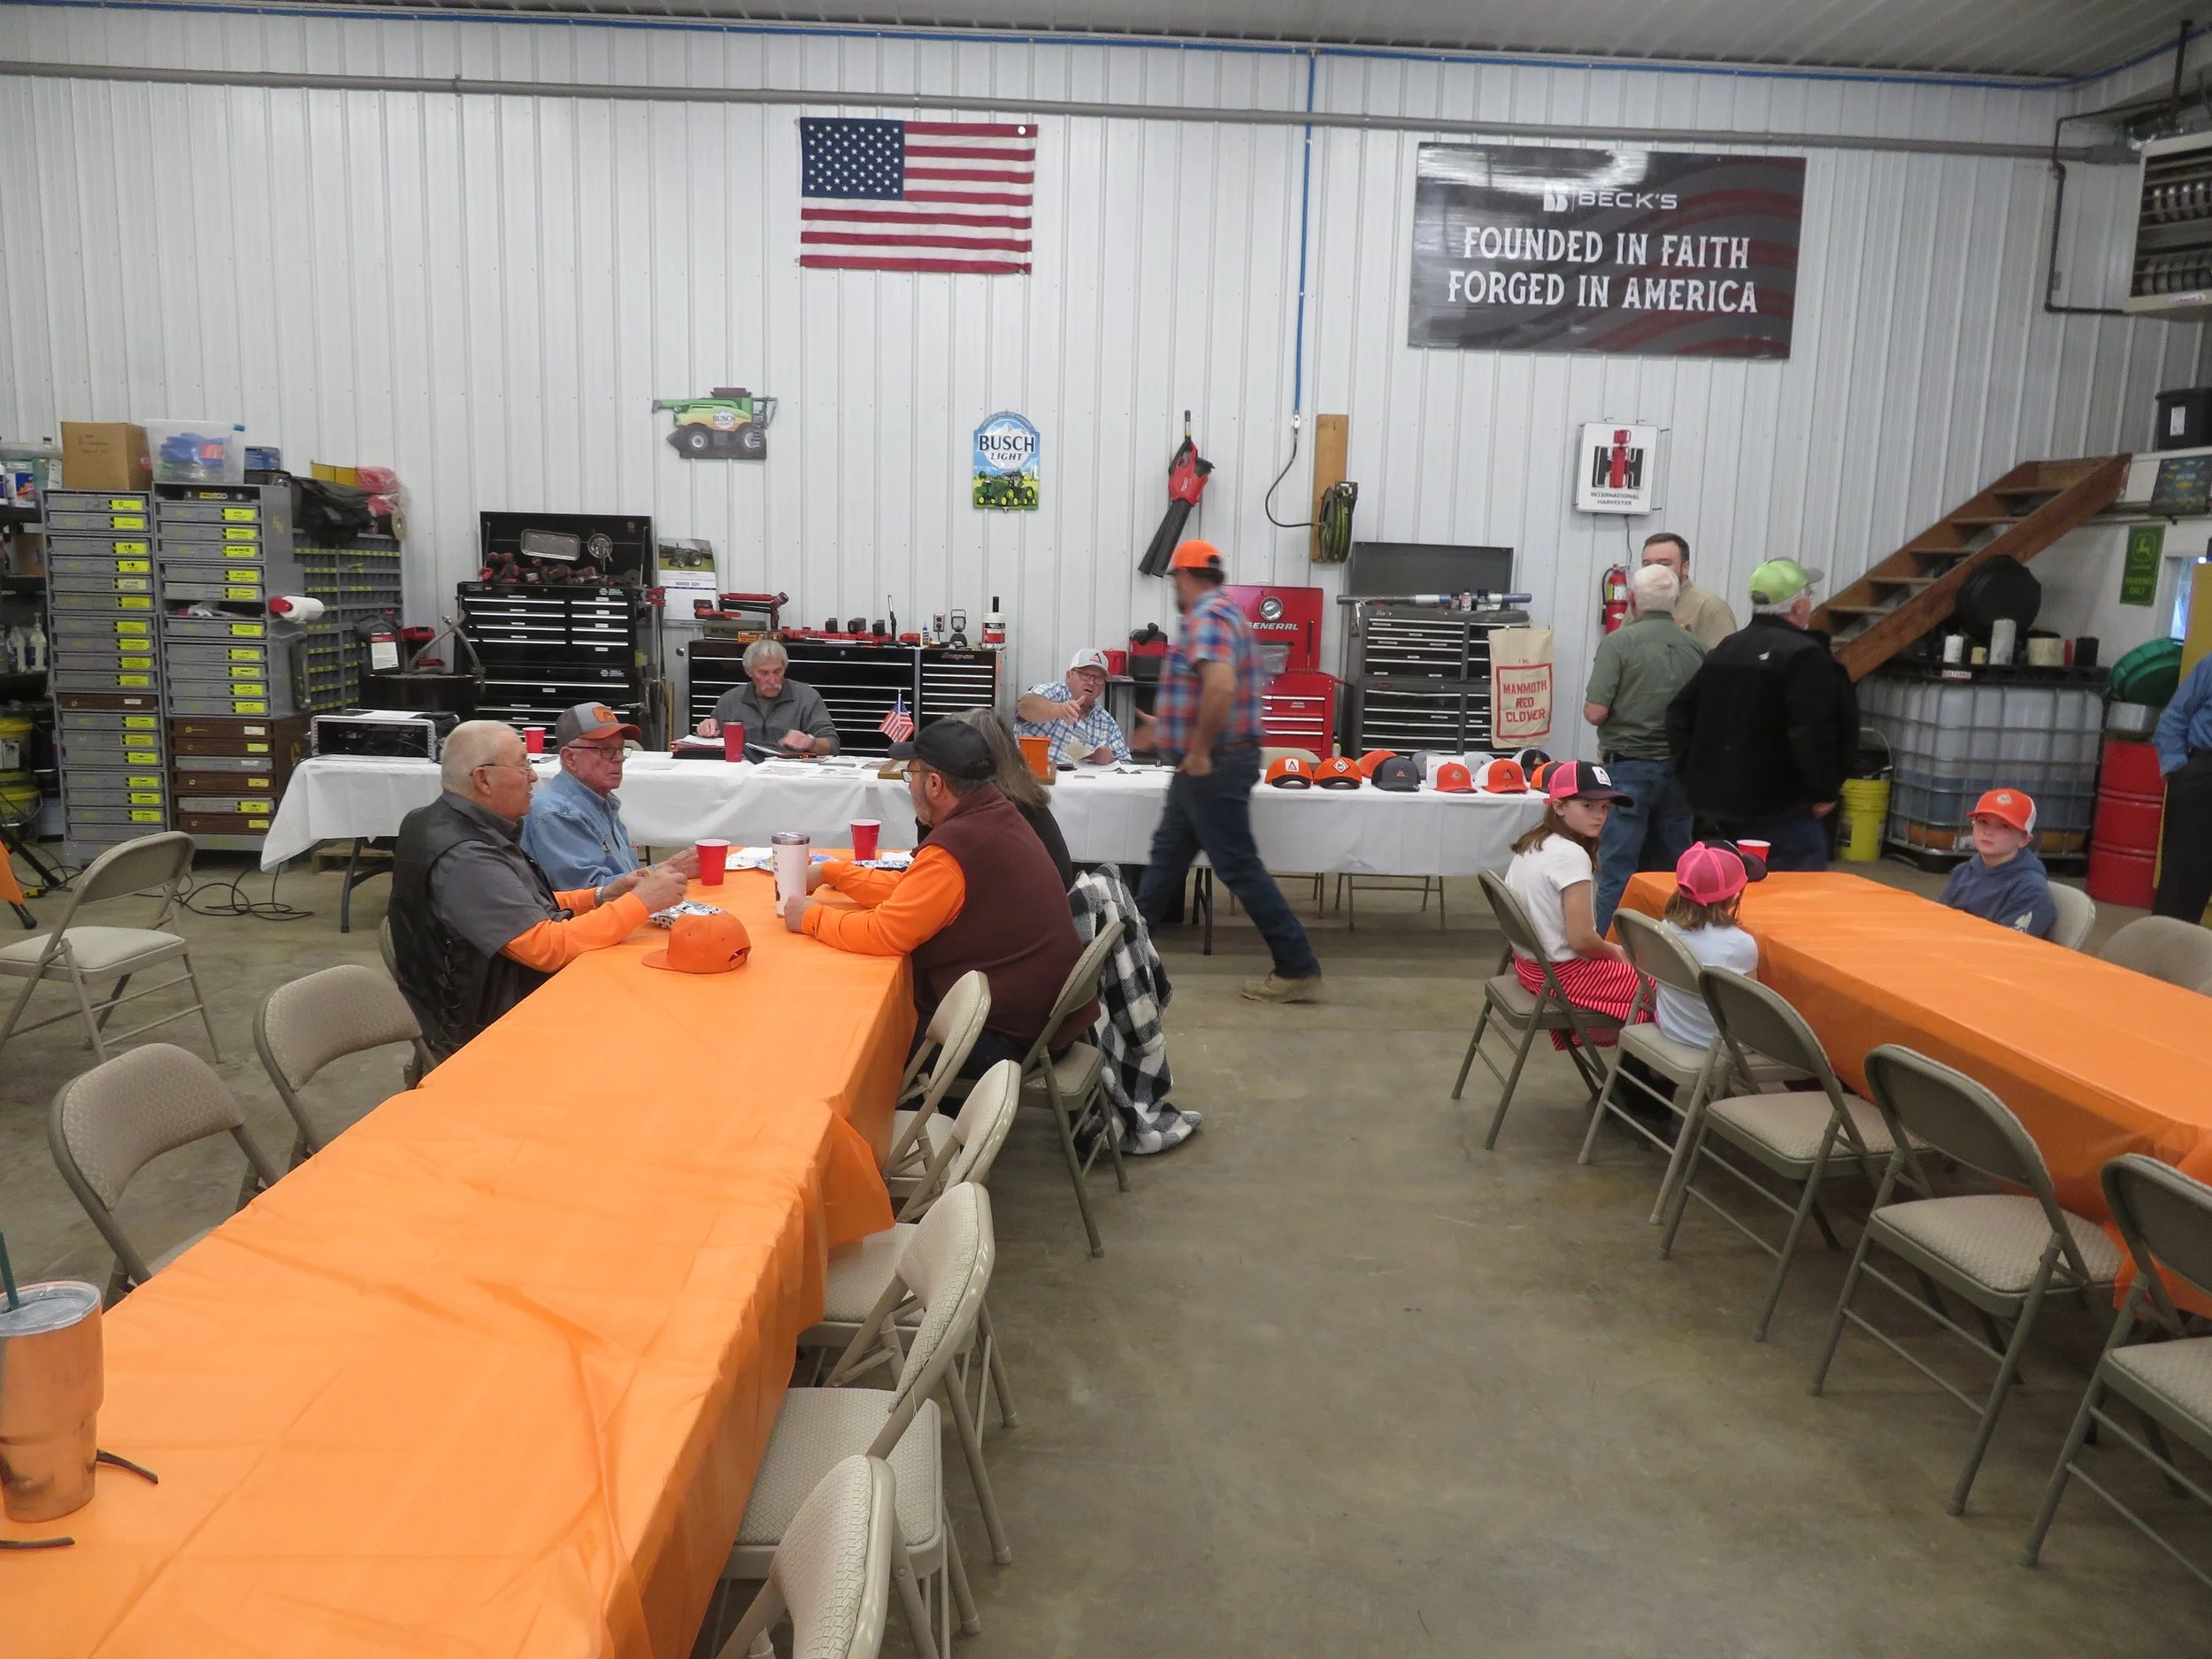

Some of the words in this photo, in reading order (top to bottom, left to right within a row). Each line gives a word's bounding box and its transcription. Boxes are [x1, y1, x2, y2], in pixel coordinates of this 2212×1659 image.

[1578, 191, 1678, 210] BECK'S
[1464, 227, 1603, 263] FOUNDED
[1616, 233, 1647, 265] IN
[1662, 234, 1750, 269] FAITH
[1448, 271, 1565, 306] FORGED
[1578, 275, 1609, 308] IN
[1621, 277, 1758, 314] AMERICA
[979, 435, 1034, 452] BUSCH
[1516, 697, 1534, 709] RED
[1505, 708, 1546, 723] CLOVER
